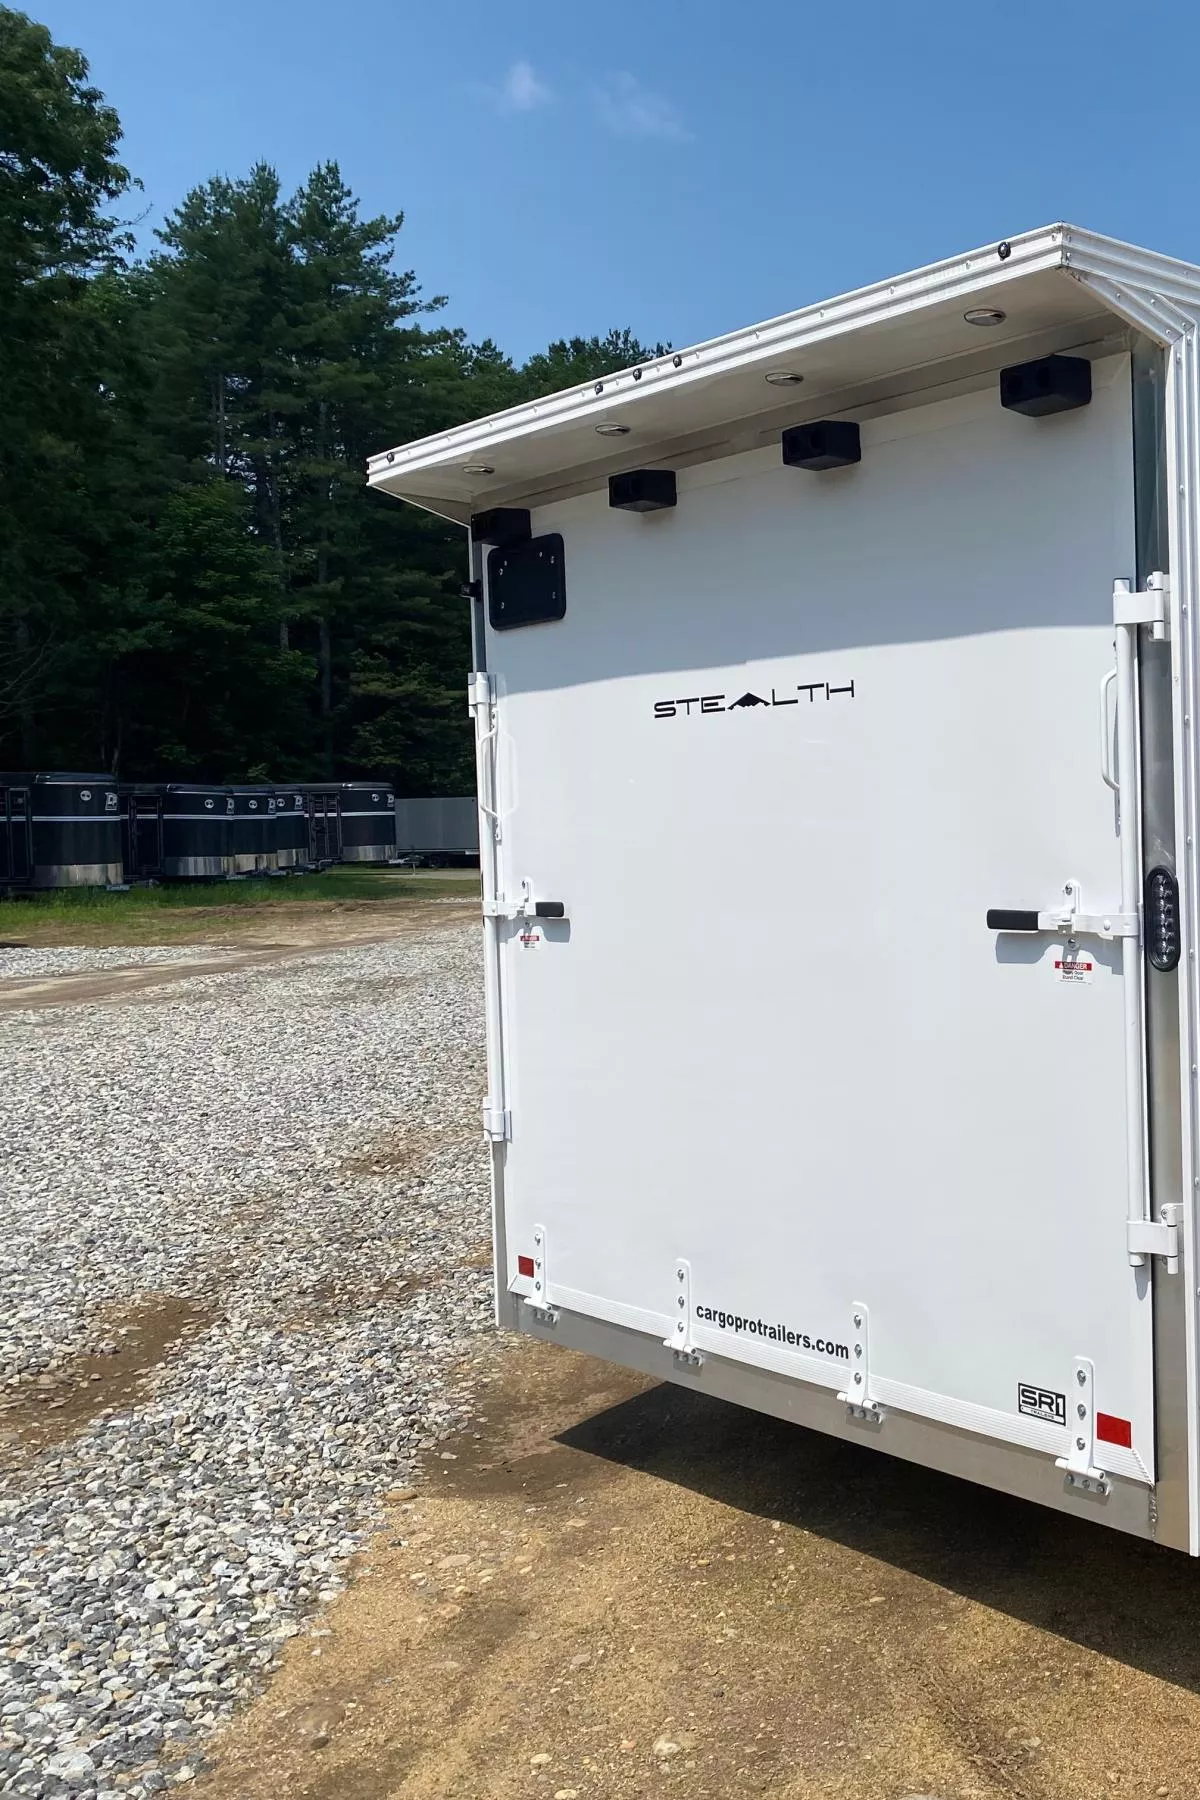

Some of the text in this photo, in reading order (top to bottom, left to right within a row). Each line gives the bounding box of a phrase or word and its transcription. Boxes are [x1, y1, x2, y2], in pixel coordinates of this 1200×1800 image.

[654, 679, 854, 719] STEALTH
[696, 1305, 849, 1360] cargoprotrailers.com
[1021, 1387, 1064, 1417] SR1
